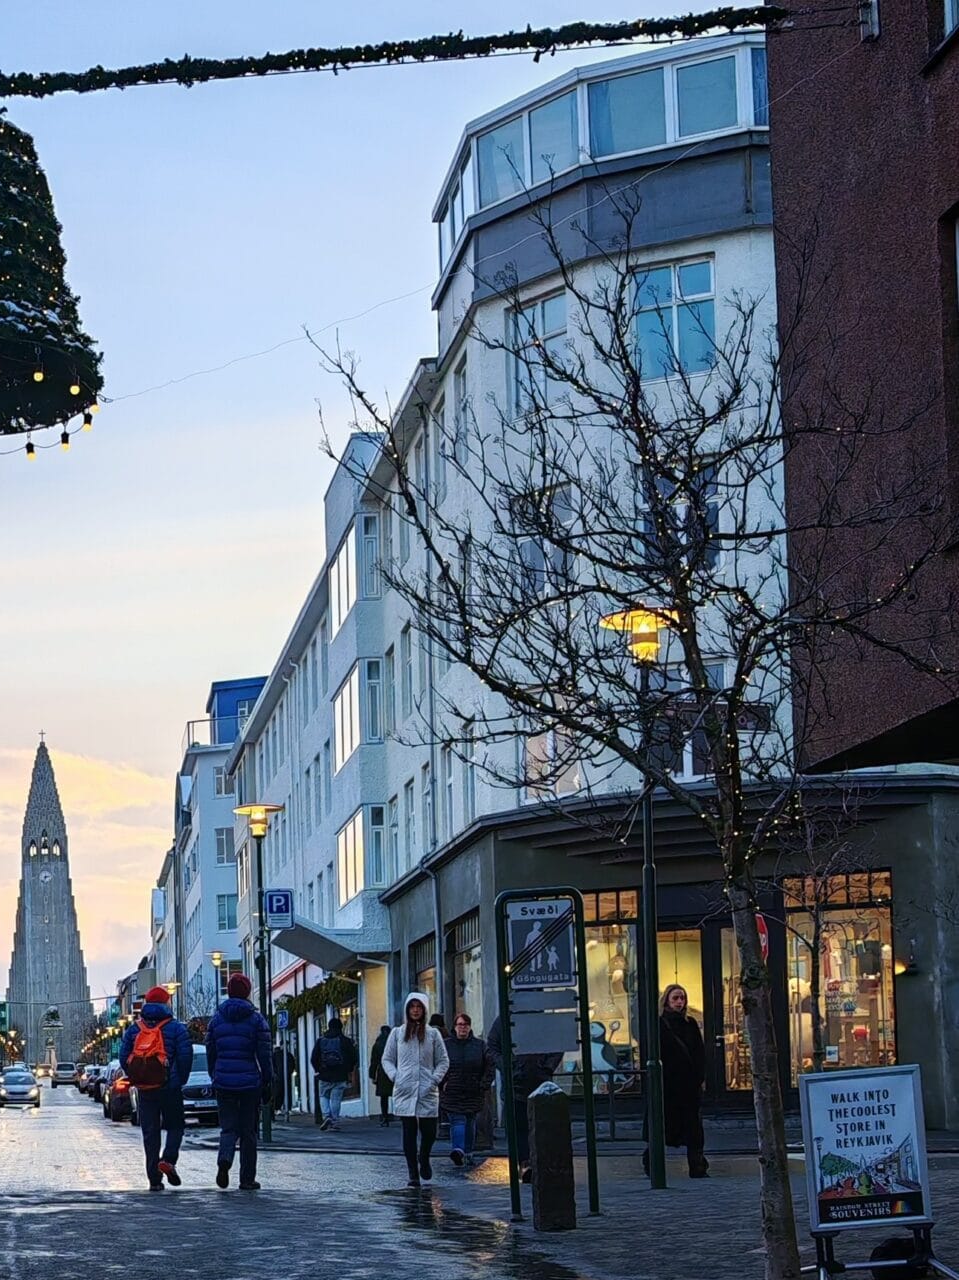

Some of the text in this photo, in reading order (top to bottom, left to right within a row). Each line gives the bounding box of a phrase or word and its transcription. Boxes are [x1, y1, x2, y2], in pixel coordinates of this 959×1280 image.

[520, 904, 559, 916] Svæði
[516, 974, 569, 985] Göngugata
[831, 1089, 890, 1104] WALK INTO
[828, 1103, 896, 1122] THE COOLEST
[836, 1120, 886, 1136] STORE IN
[836, 1134, 893, 1149] REYKJAVIK
[831, 1206, 891, 1219] SOUVENIRS
